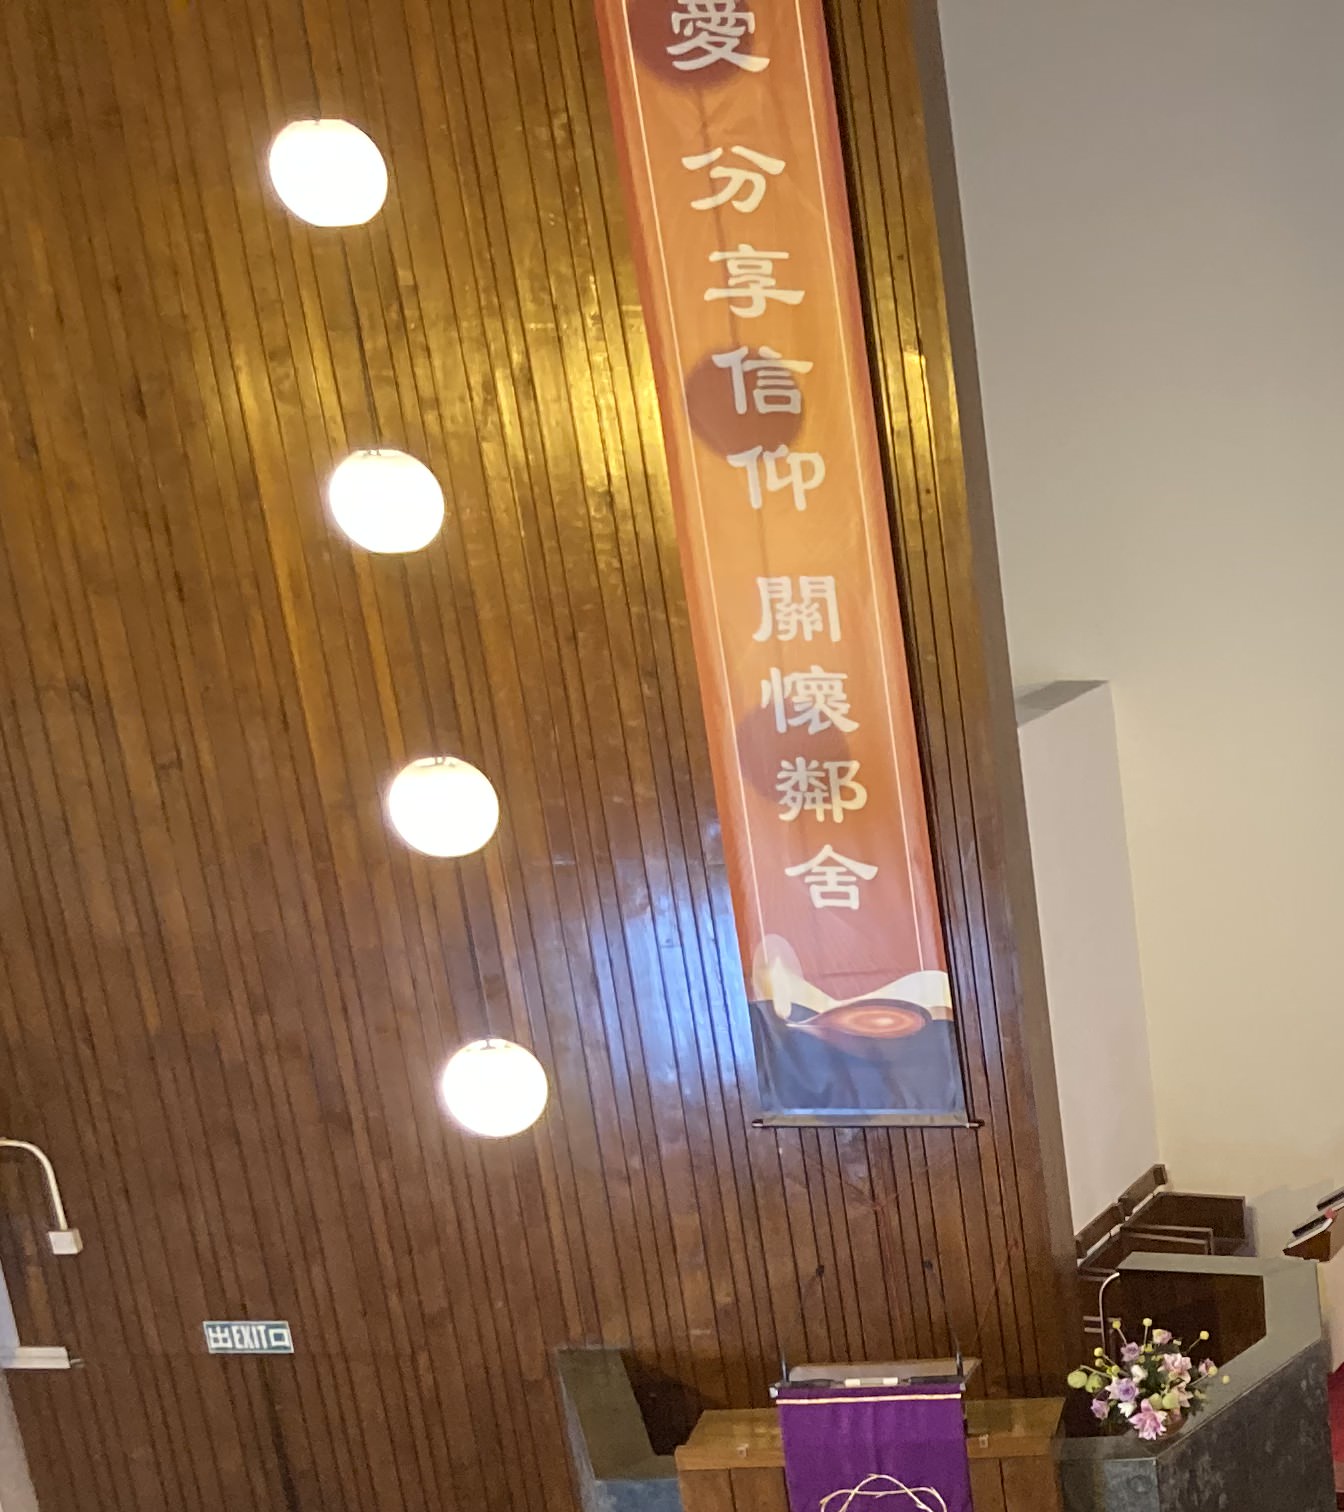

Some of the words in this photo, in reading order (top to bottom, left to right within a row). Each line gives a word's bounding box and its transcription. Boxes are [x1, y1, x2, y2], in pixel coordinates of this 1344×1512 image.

[666, 0, 770, 72] 愛
[681, 145, 825, 512] 分享信仰
[752, 575, 879, 910] 關懷鄰舍
[207, 1325, 233, 1349] 出
[232, 1325, 268, 1350] EXIT
[268, 1327, 290, 1347] 口
